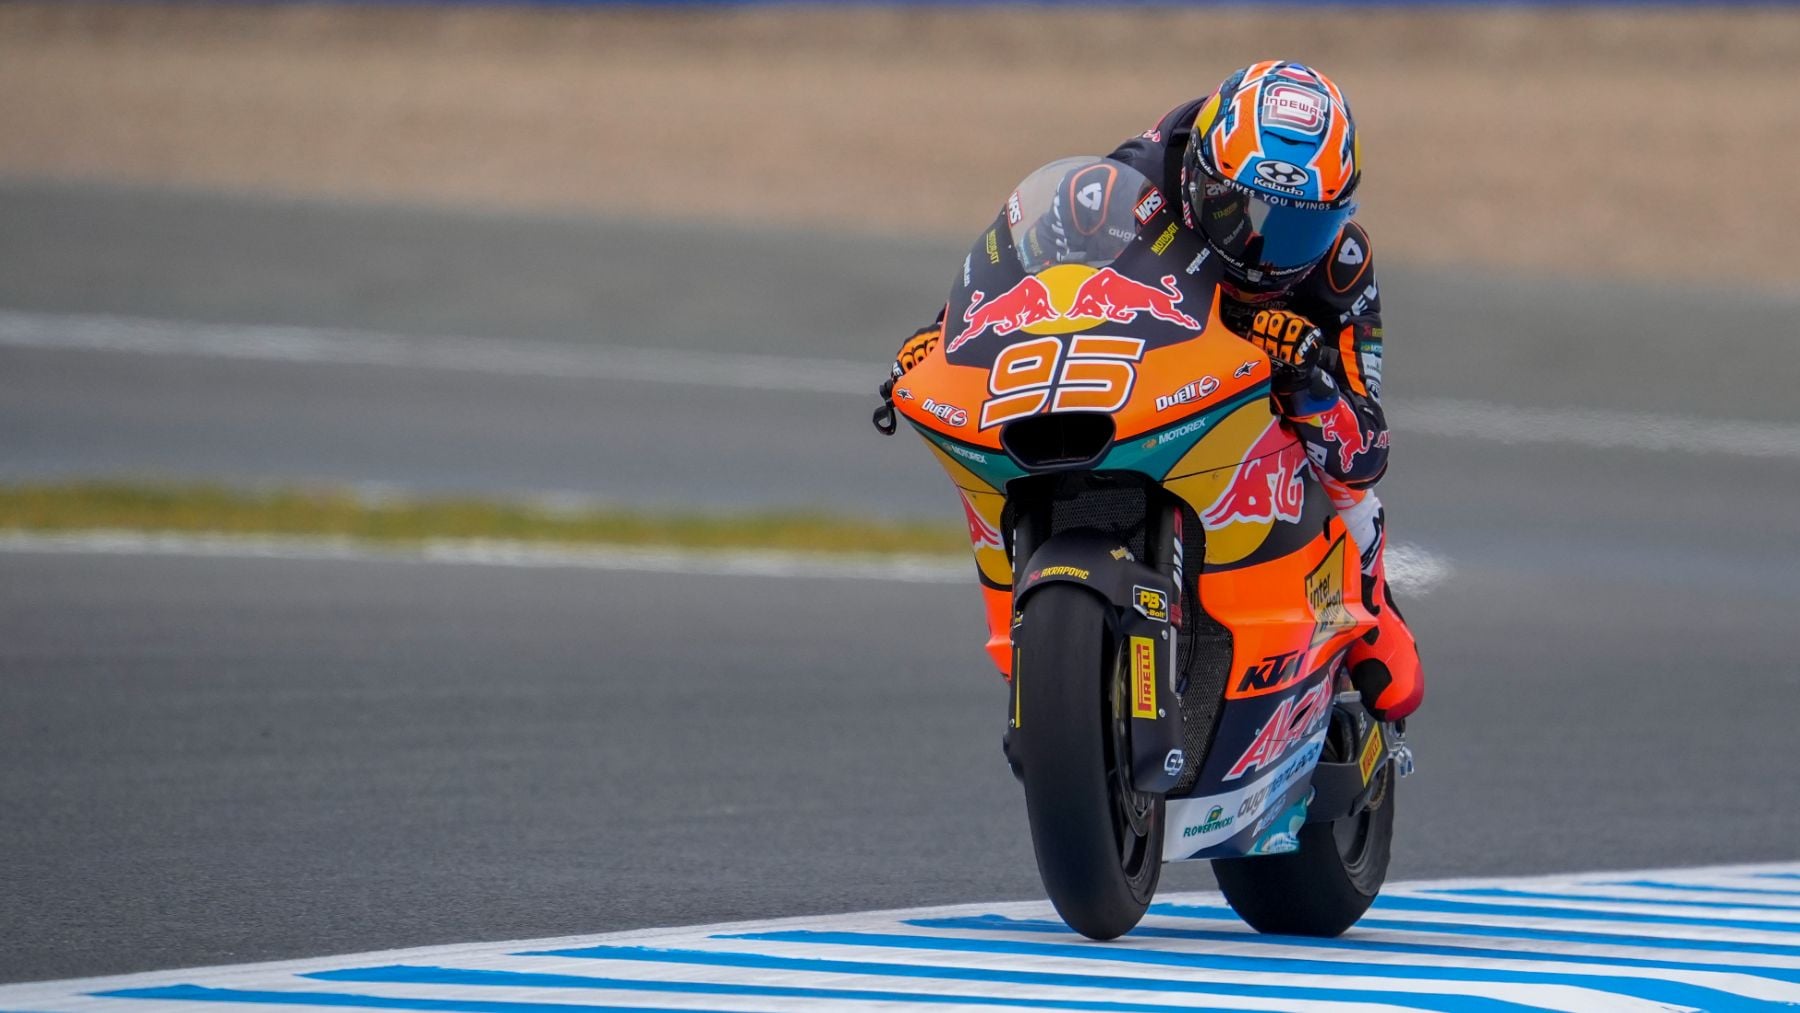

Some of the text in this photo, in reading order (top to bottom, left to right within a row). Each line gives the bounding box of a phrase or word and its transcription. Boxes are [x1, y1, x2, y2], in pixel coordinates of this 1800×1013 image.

[1223, 179, 1256, 198] GIVES
[1263, 193, 1288, 207] YOU
[1294, 200, 1331, 211] WINGS
[1253, 177, 1304, 197] Kabuto
[1135, 190, 1162, 221] WRS
[1151, 222, 1179, 252] MOTOBATT
[979, 336, 1145, 429] 95
[1159, 417, 1207, 444] MOTOREX
[1136, 643, 1152, 711] PIRELLI
[1236, 650, 1305, 692] KTM
